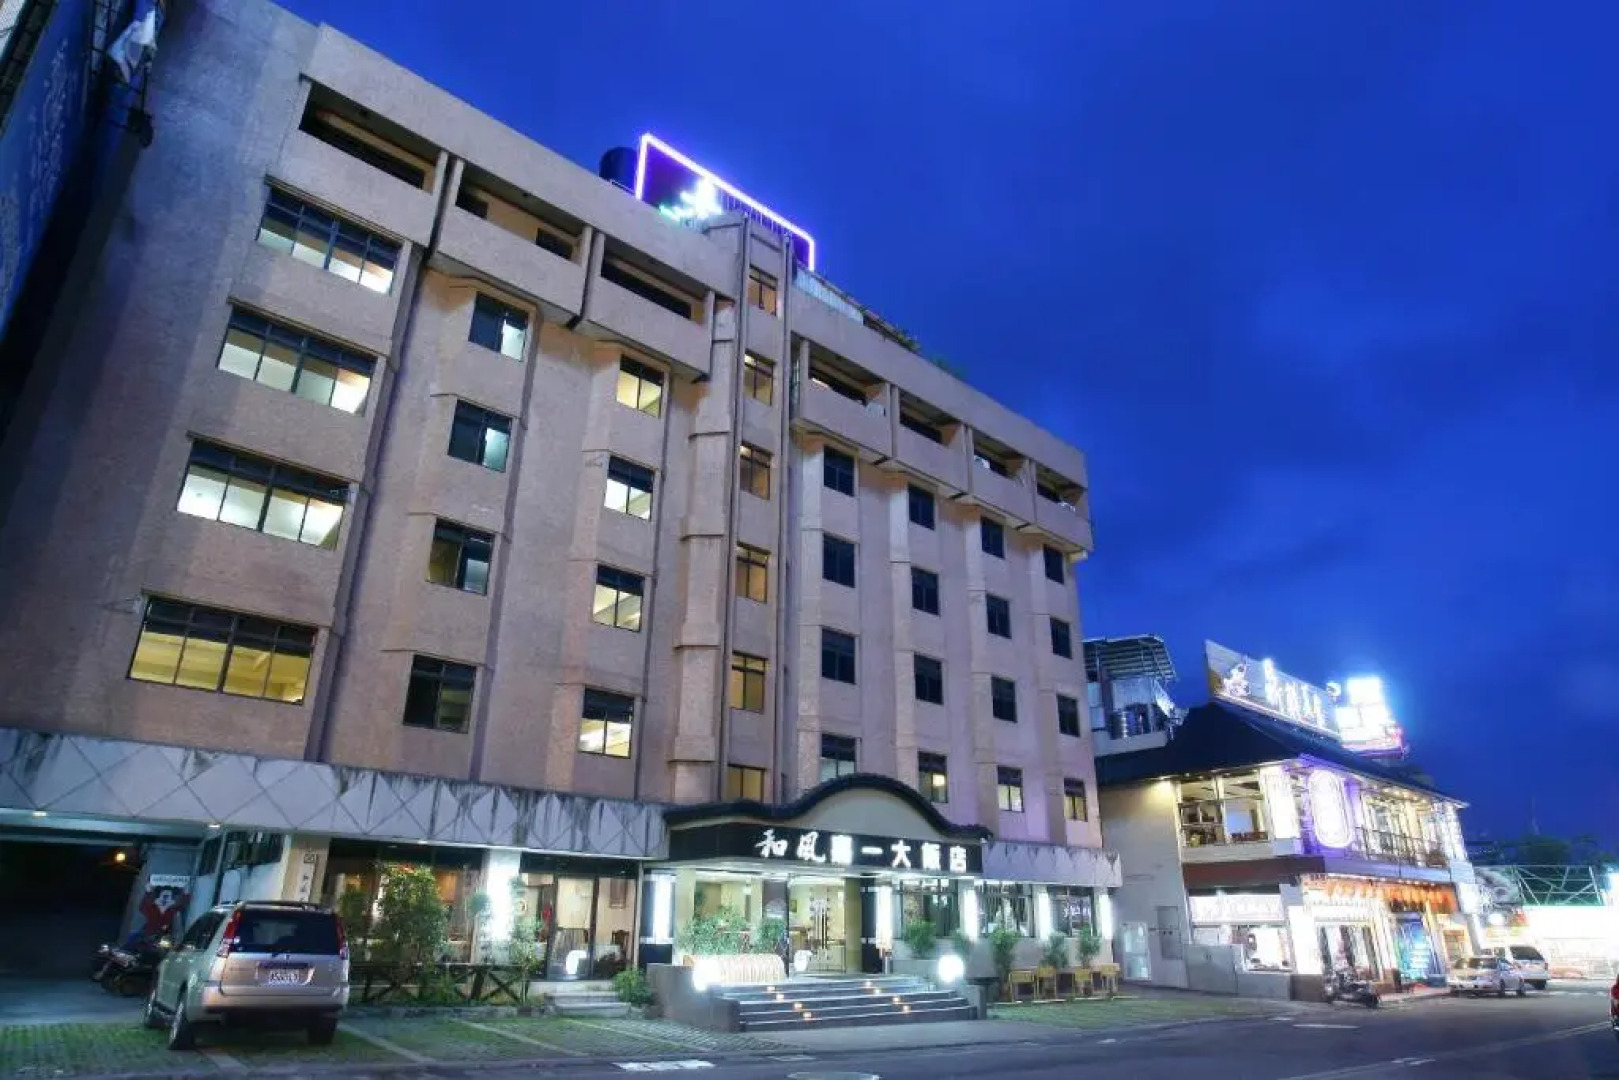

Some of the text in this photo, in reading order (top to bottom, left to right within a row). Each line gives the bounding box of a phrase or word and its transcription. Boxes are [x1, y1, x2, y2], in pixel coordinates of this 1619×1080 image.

[756, 829, 966, 872] 和風一大飯店
